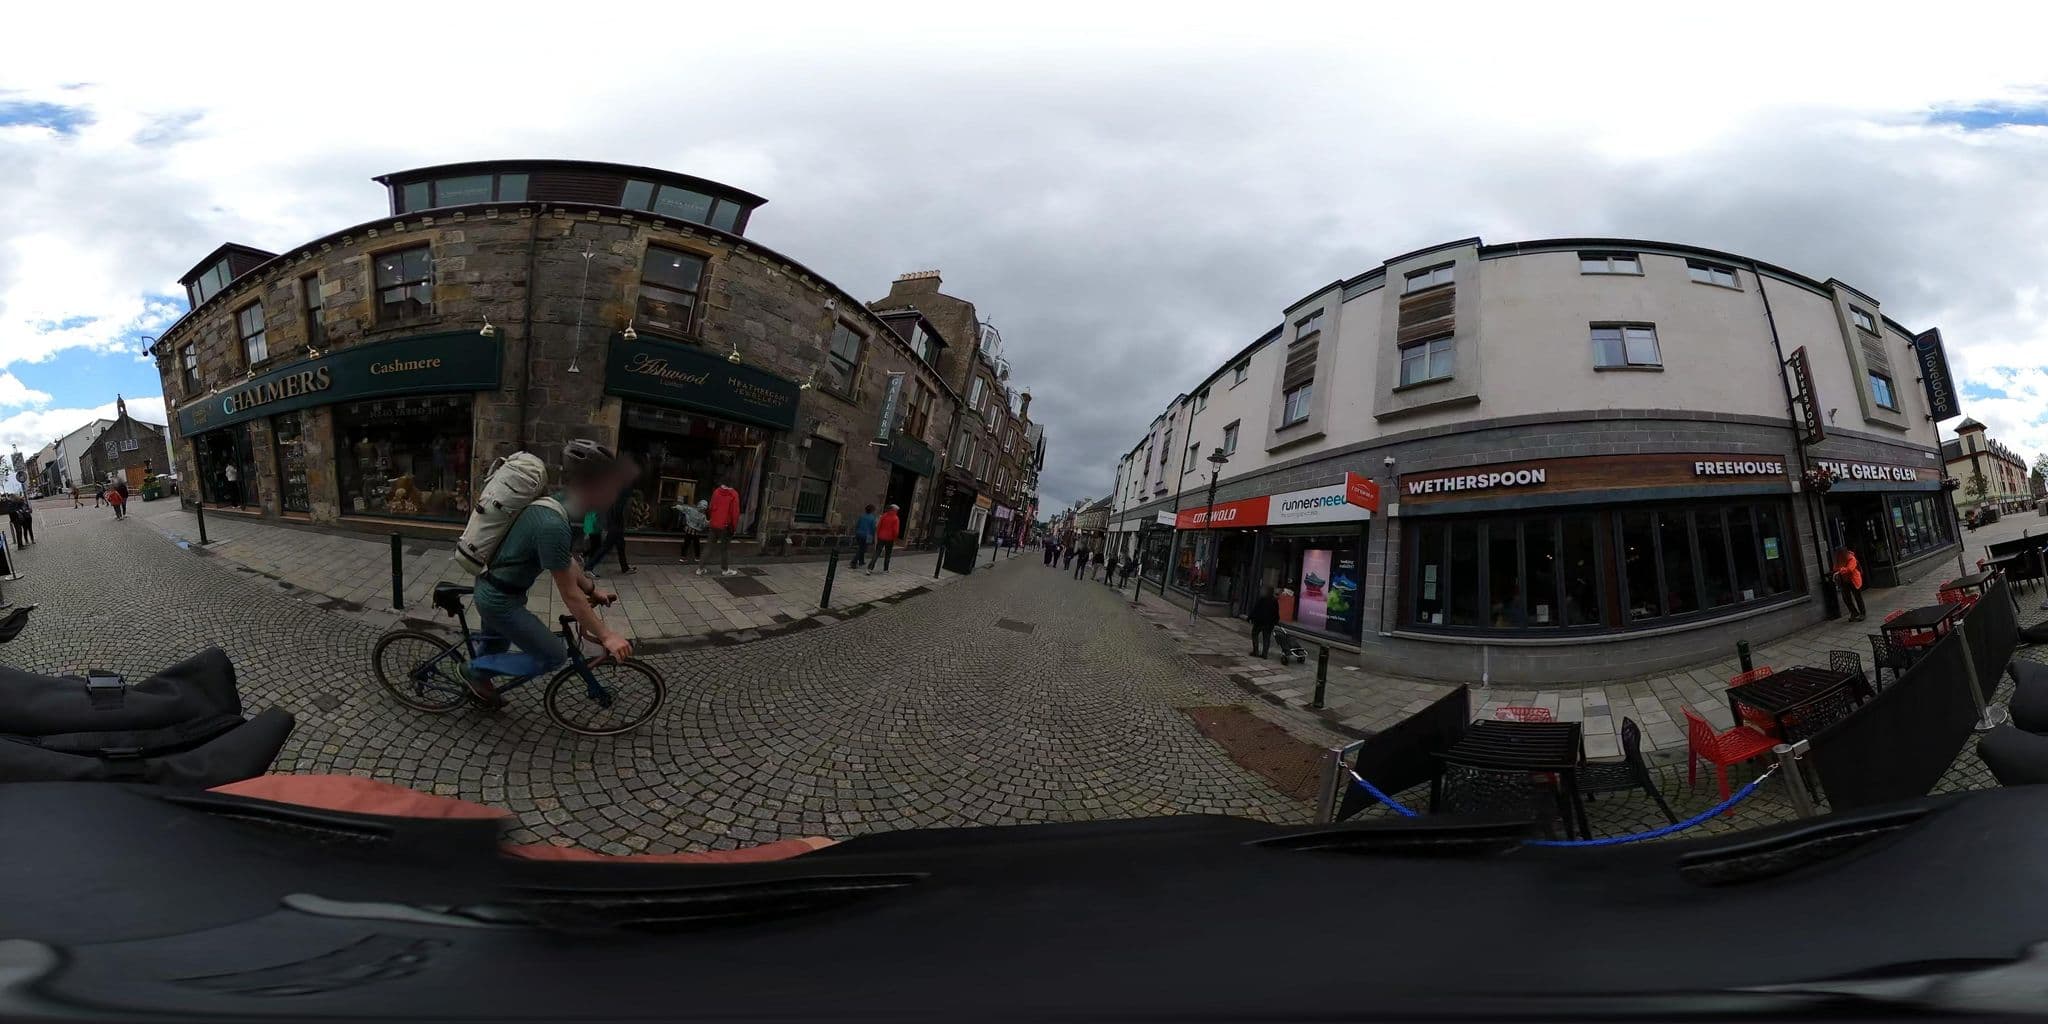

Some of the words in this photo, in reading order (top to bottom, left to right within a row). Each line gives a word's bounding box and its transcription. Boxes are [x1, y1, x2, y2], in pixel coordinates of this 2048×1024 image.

[370, 358, 441, 375] Cashmere
[624, 353, 710, 385] Ashwood
[223, 366, 331, 415] CHALMERS
[1793, 352, 1817, 436] WETHERSPOON
[1925, 349, 1949, 413] Travelodge
[880, 377, 898, 438] GALLERY
[1408, 469, 1545, 494] WETHERSPOON
[1695, 461, 1783, 475] FREEHOUSE
[1818, 461, 1849, 479] THE
[1851, 464, 1891, 480] GREAT
[1892, 468, 1917, 481] GLEN
[1193, 508, 1237, 523] COTWOLD
